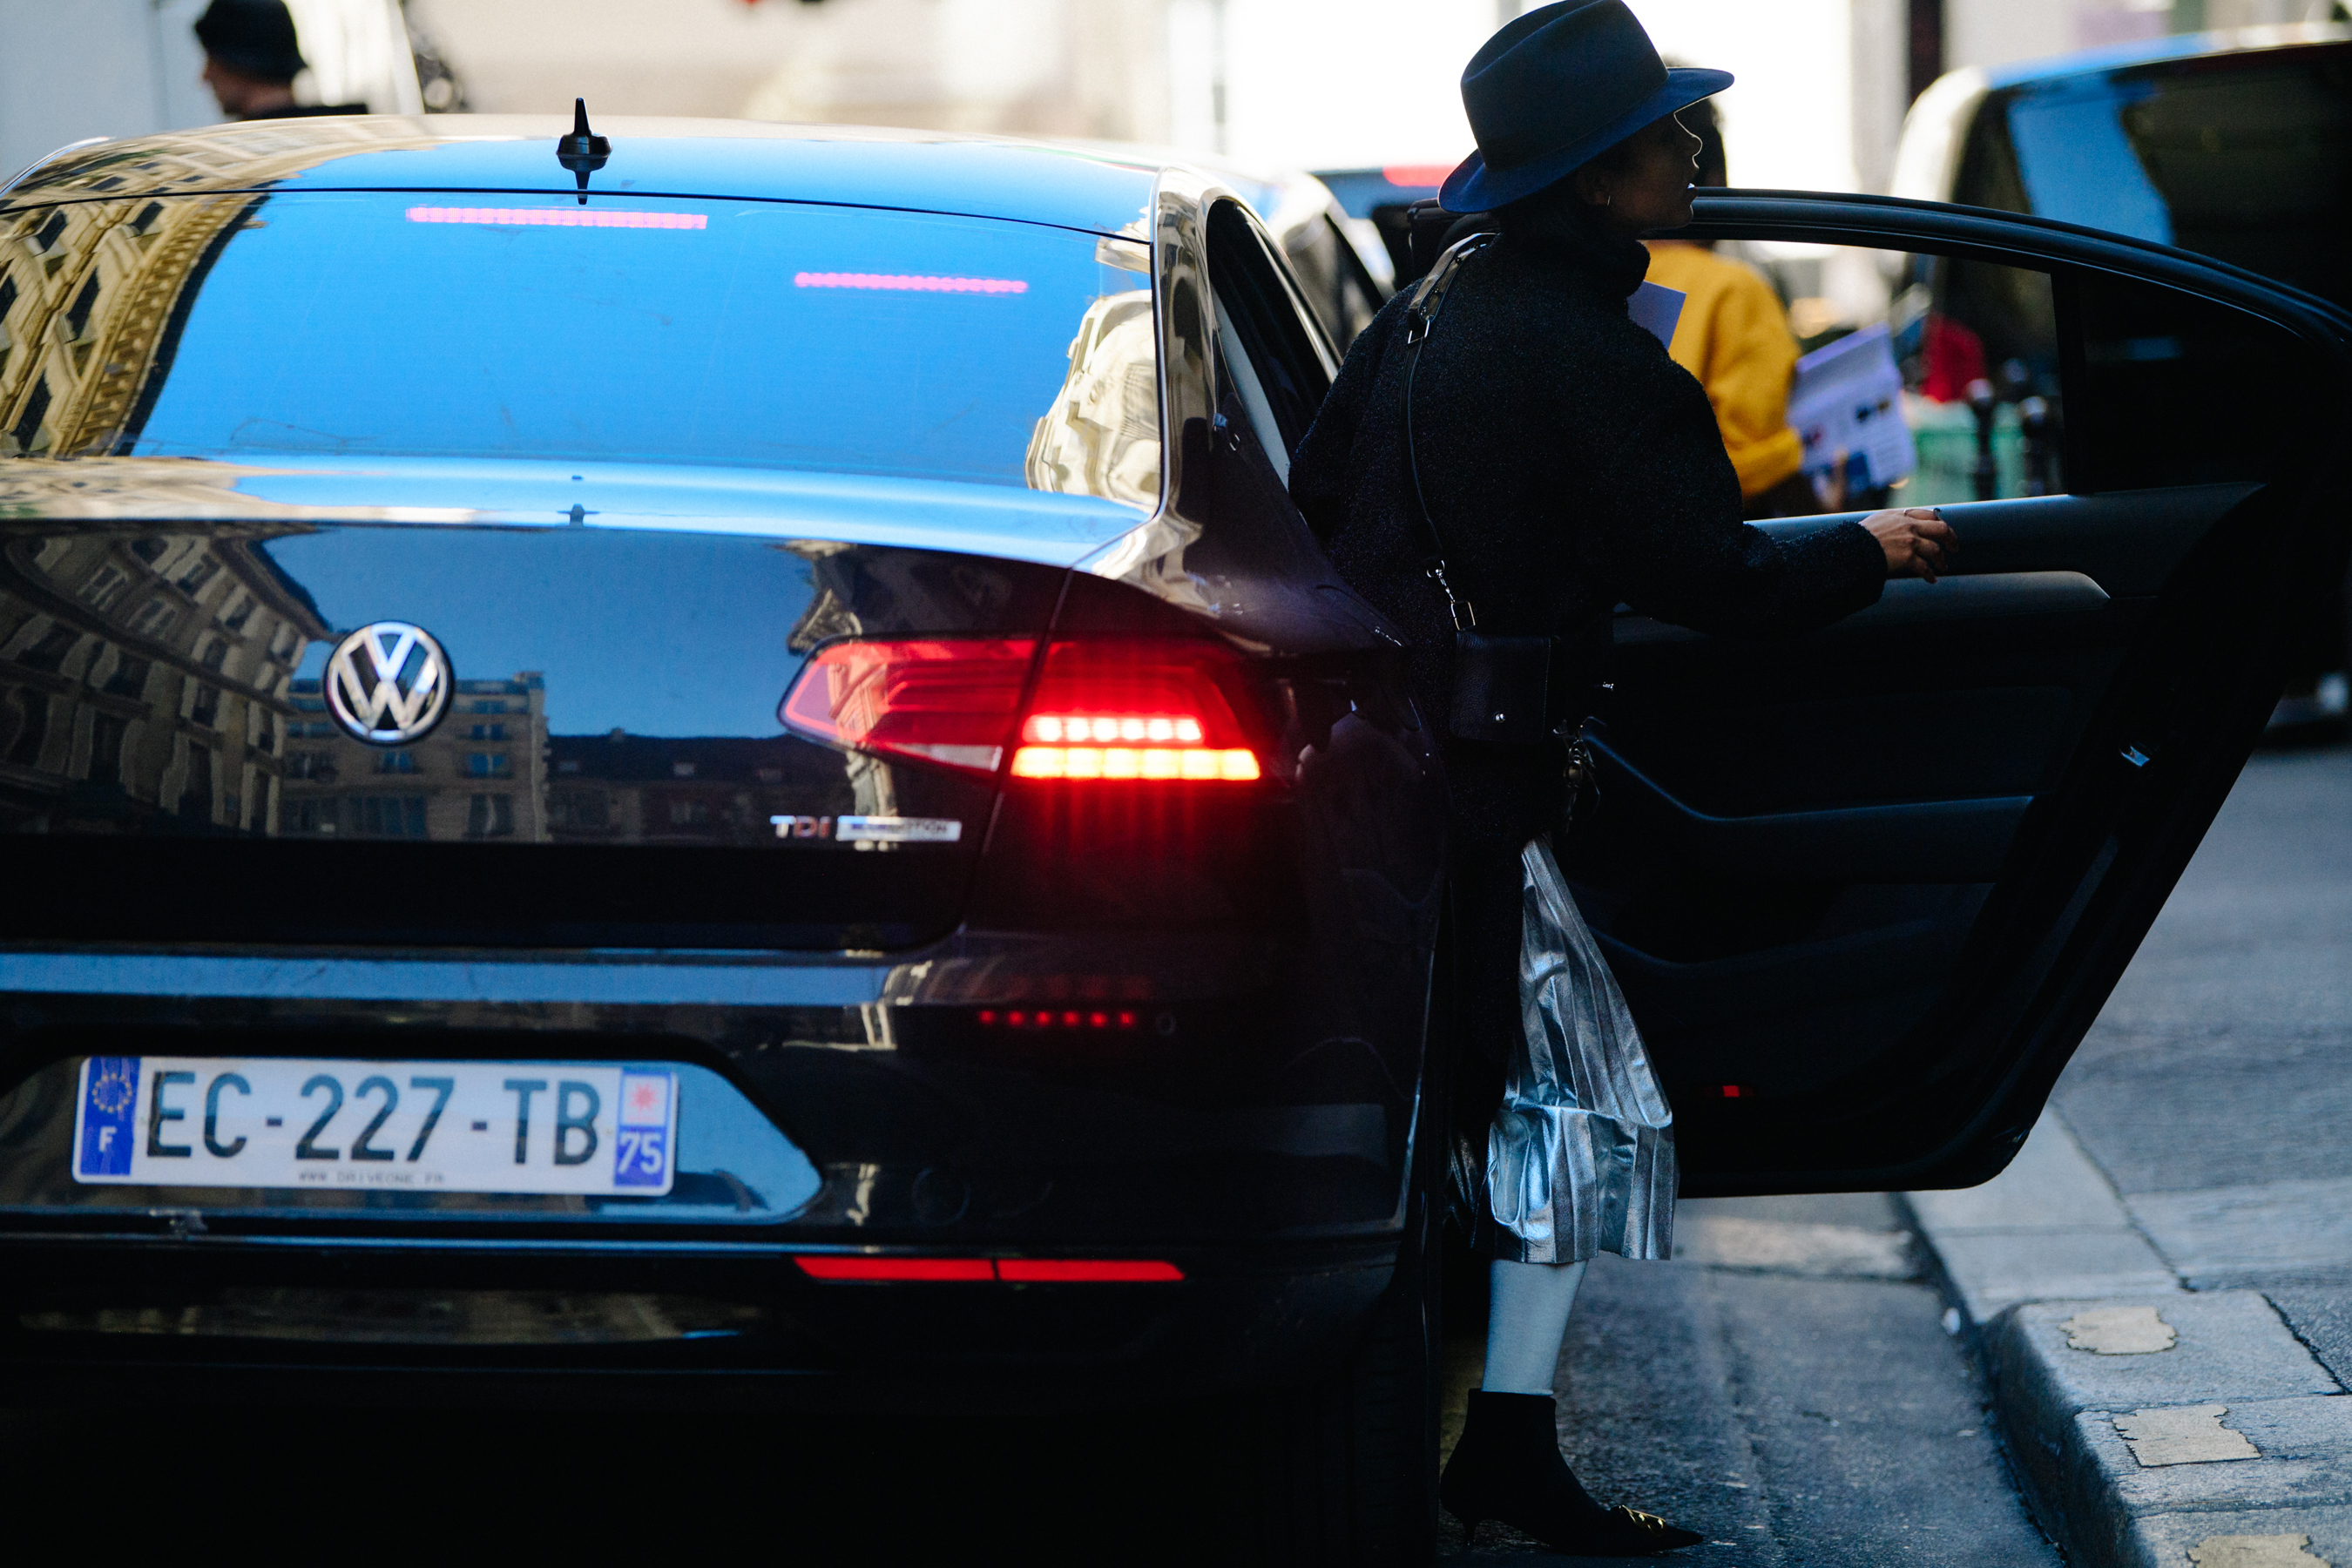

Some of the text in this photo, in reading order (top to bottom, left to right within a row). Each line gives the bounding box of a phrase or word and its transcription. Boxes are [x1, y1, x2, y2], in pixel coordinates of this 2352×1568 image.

[328, 622, 446, 740] VW
[770, 815, 831, 839] TDI
[98, 1126, 117, 1152] F
[147, 1071, 600, 1166] EC-227-TB
[617, 1132, 663, 1174] 75
